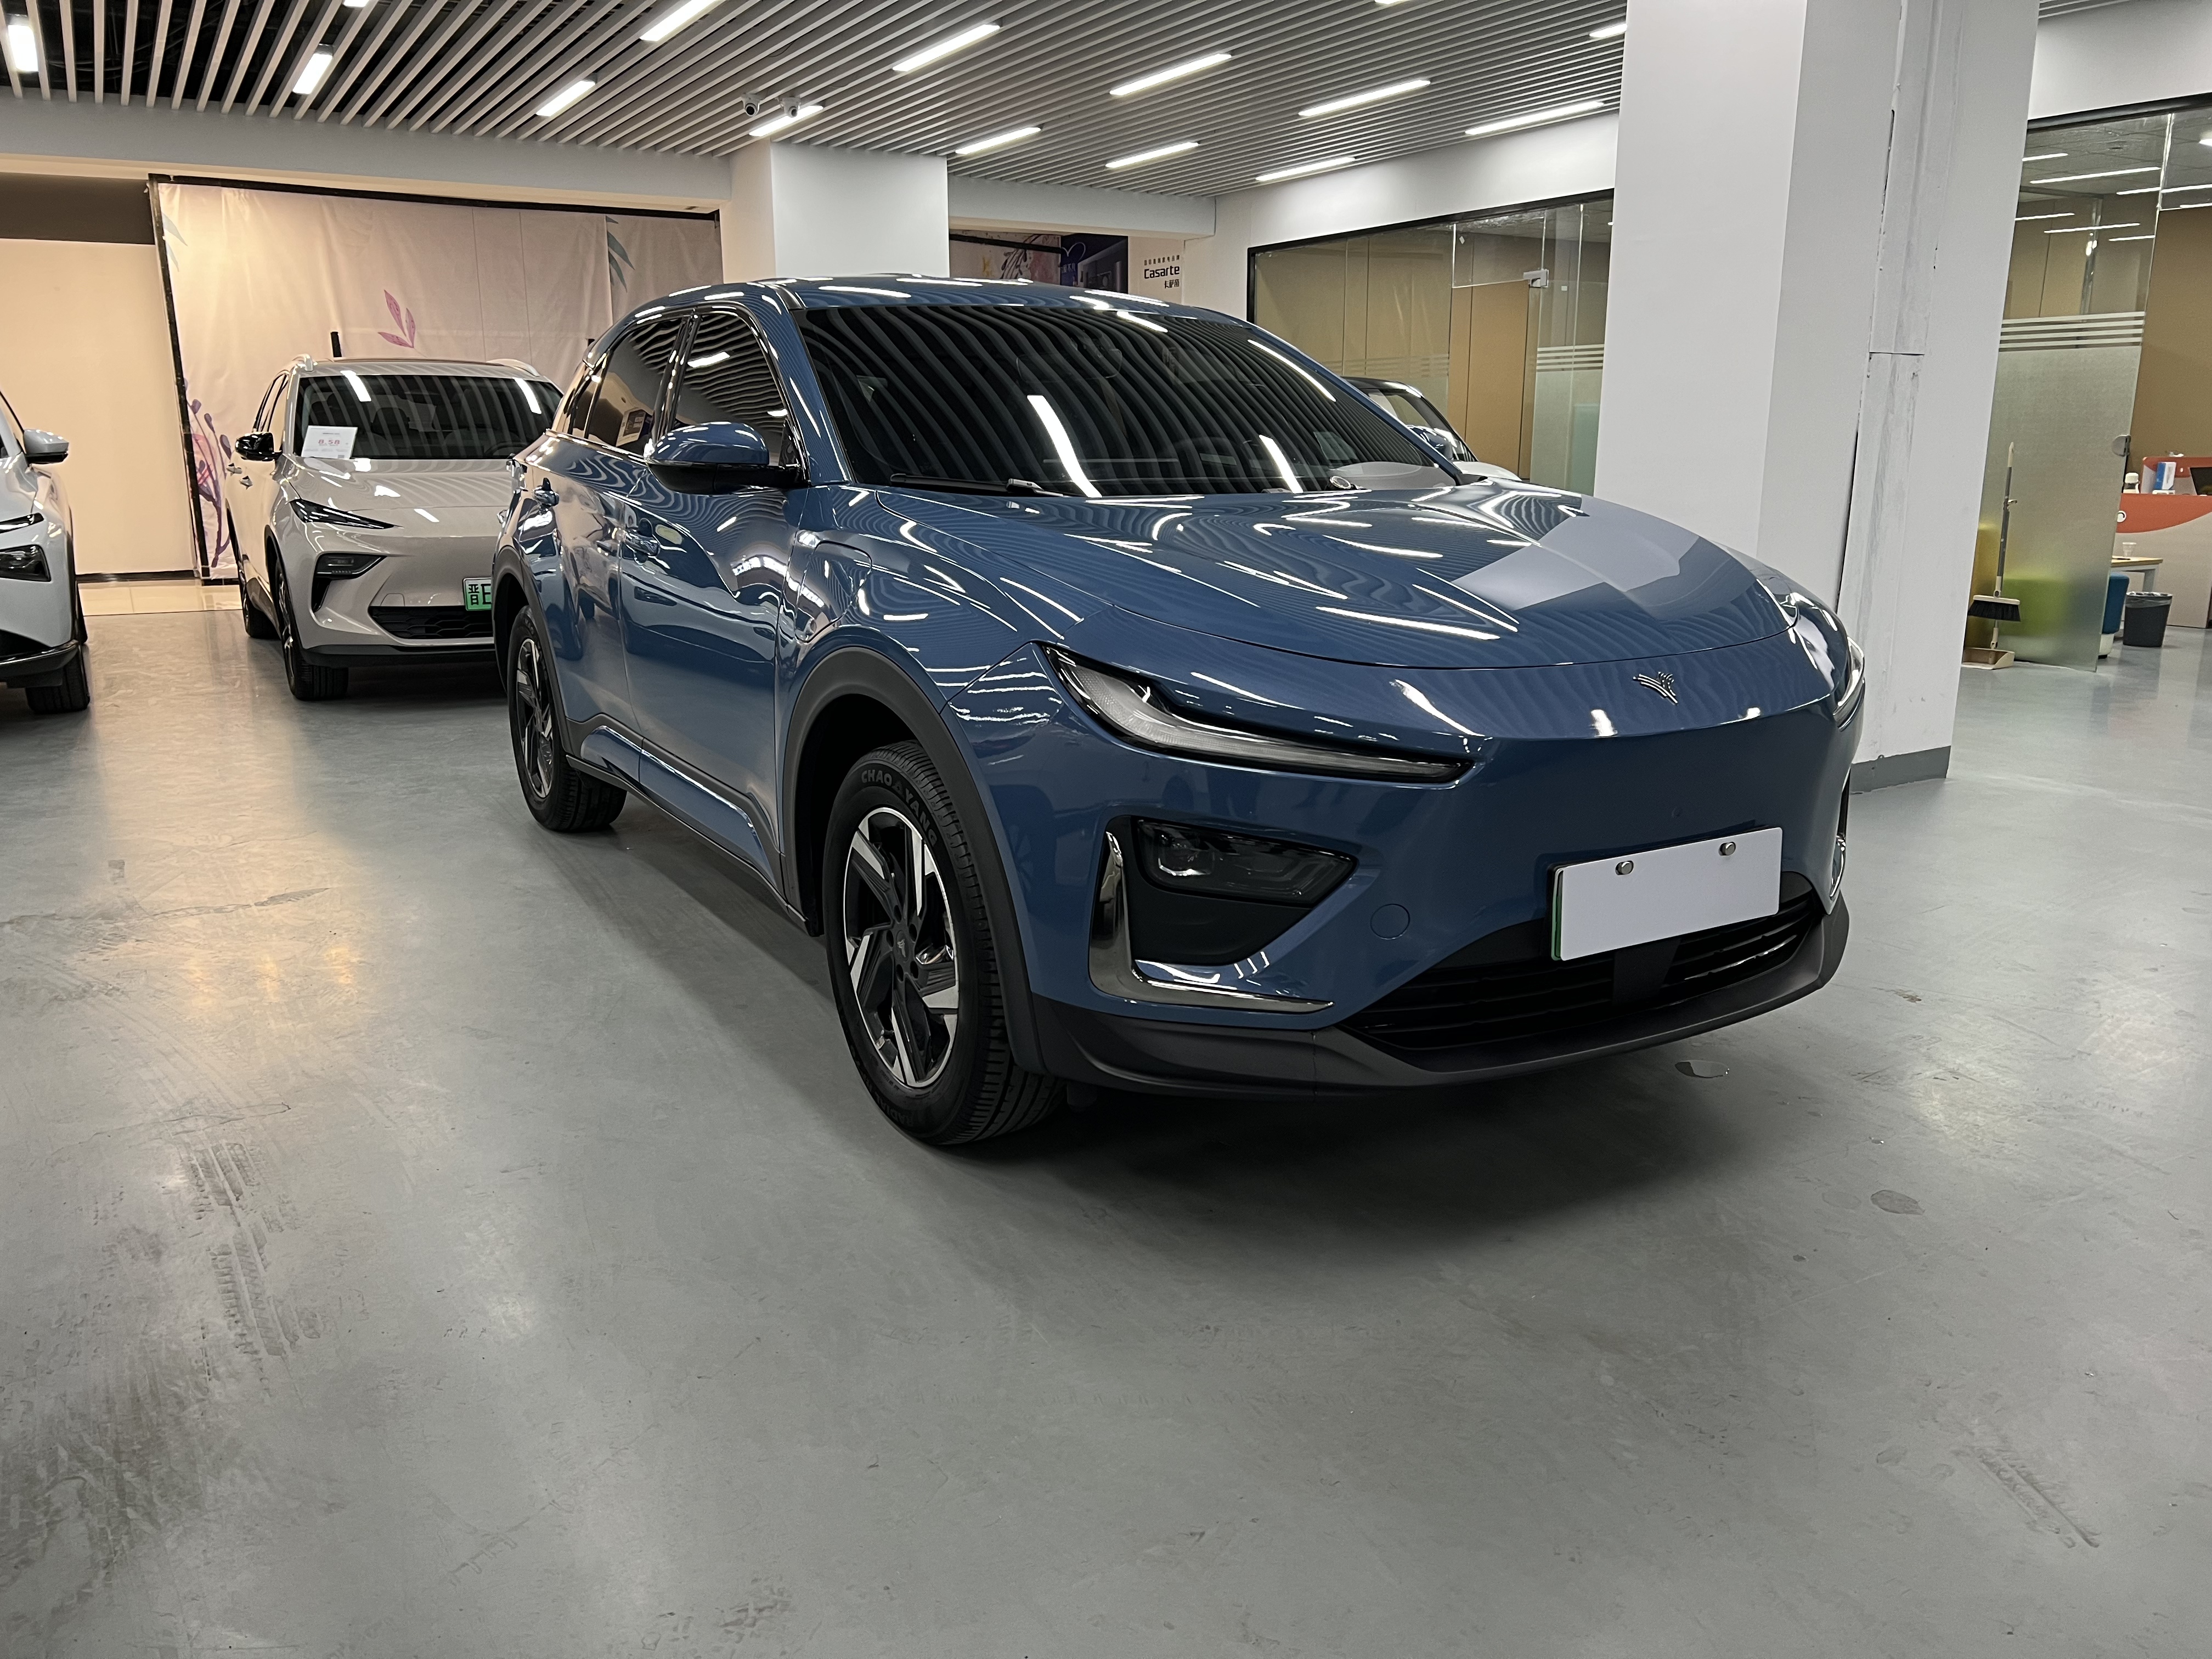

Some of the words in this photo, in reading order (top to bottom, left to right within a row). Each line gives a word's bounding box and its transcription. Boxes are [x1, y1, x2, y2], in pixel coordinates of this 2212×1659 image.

[1144, 266, 1180, 279] Casarte
[861, 769, 893, 786] CHAO
[905, 788, 938, 848] YANG
